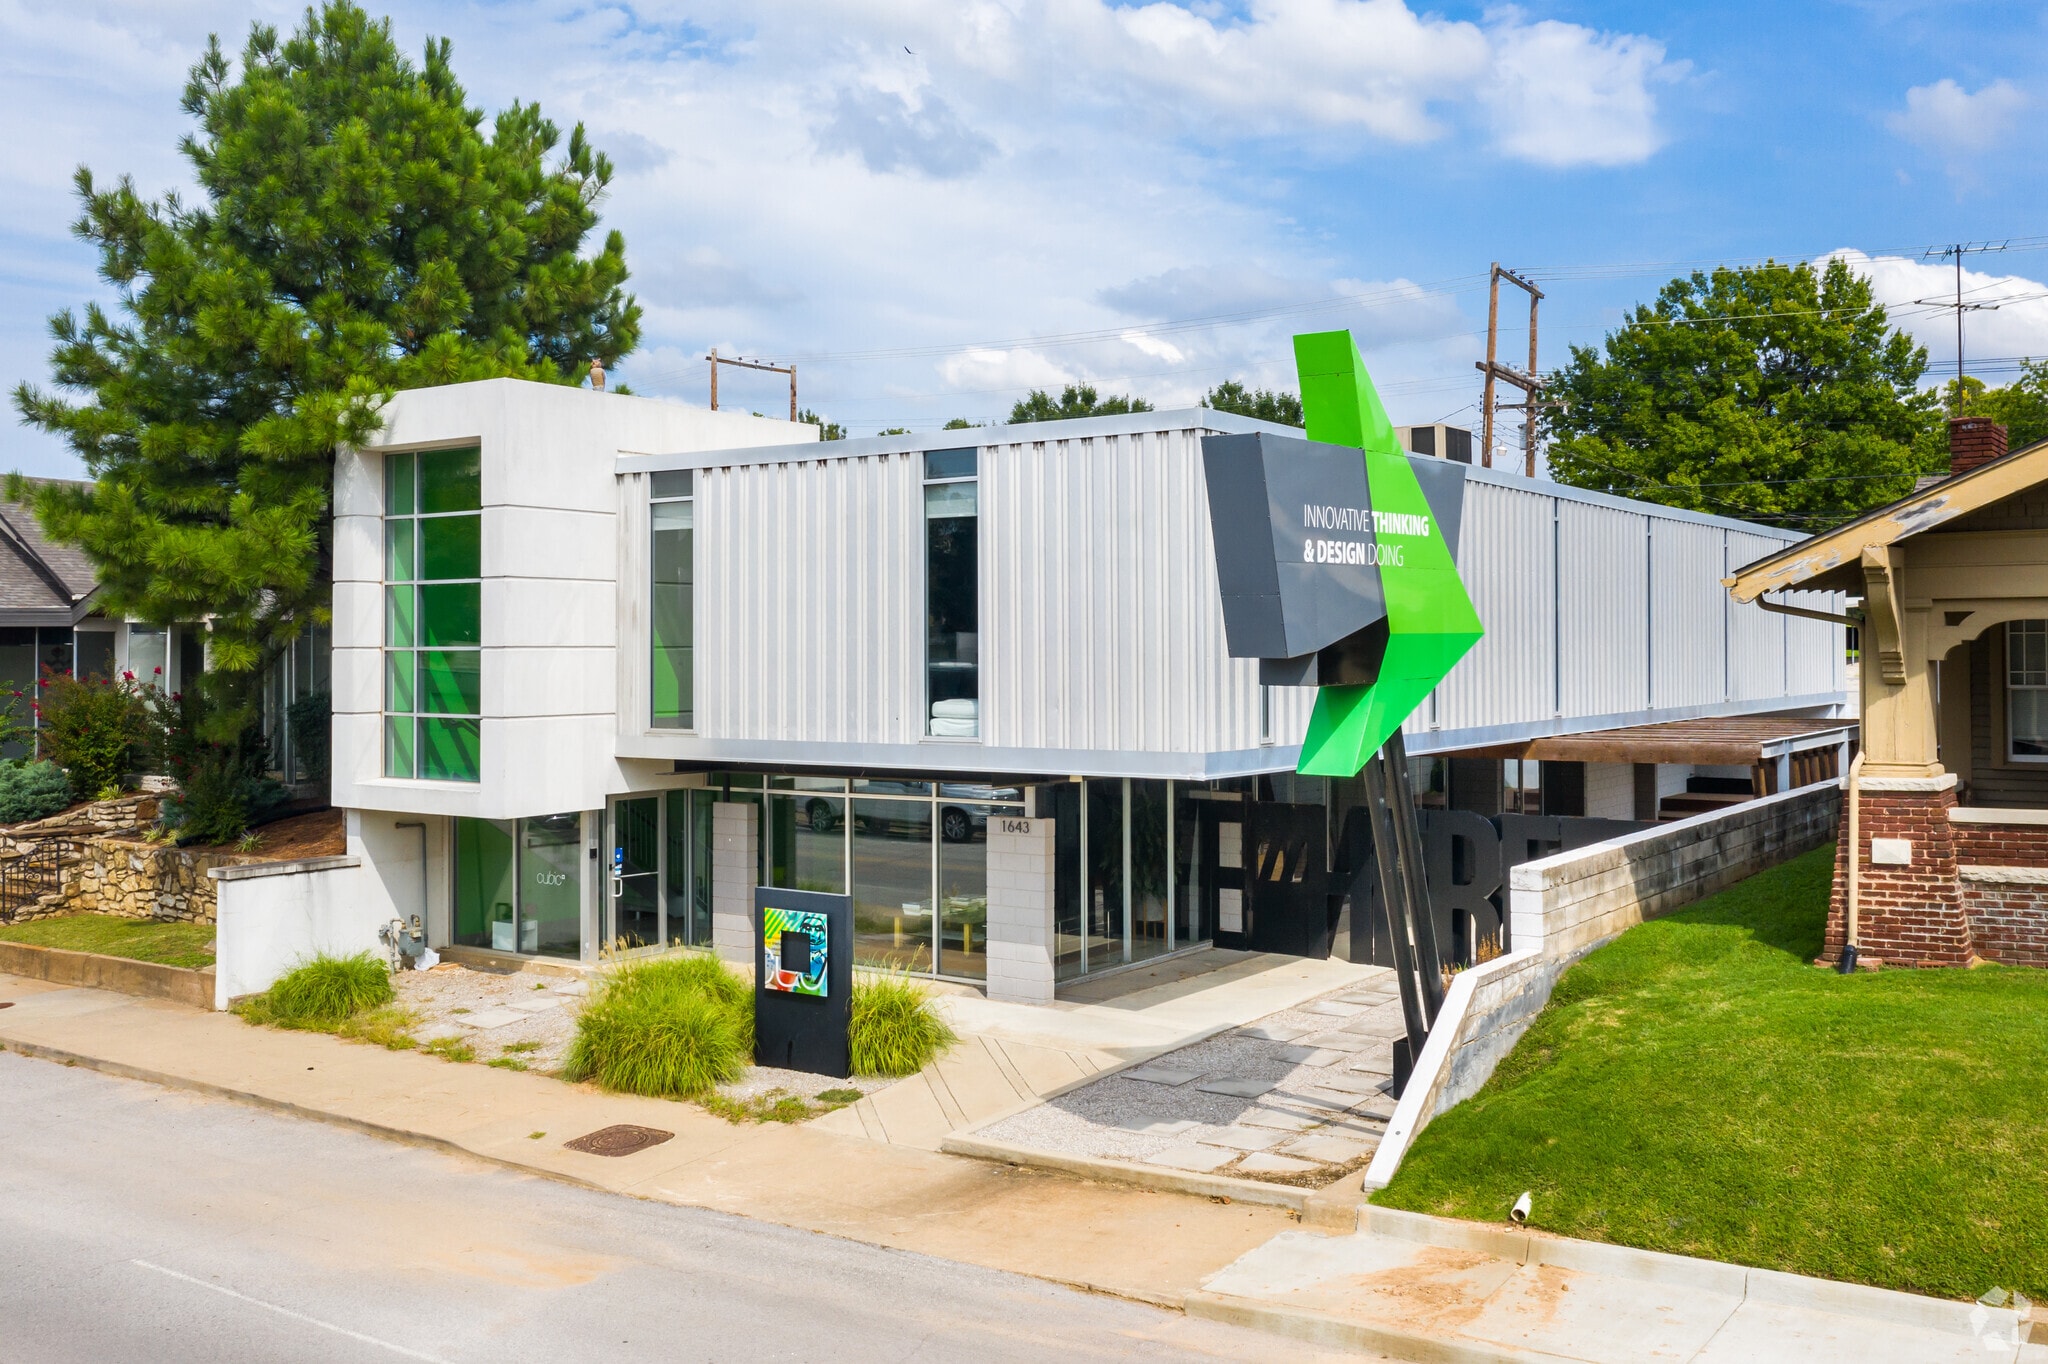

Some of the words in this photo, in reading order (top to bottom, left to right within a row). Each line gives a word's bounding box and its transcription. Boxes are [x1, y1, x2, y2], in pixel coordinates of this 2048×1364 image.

[1303, 504, 1370, 532] INNOVATIVE
[1371, 510, 1430, 537] THINKING
[1303, 538, 1315, 563] &
[1317, 539, 1366, 565] DESIGN
[1367, 543, 1404, 567] DOING
[1002, 820, 1030, 834] 1643
[536, 870, 563, 886] cubic
